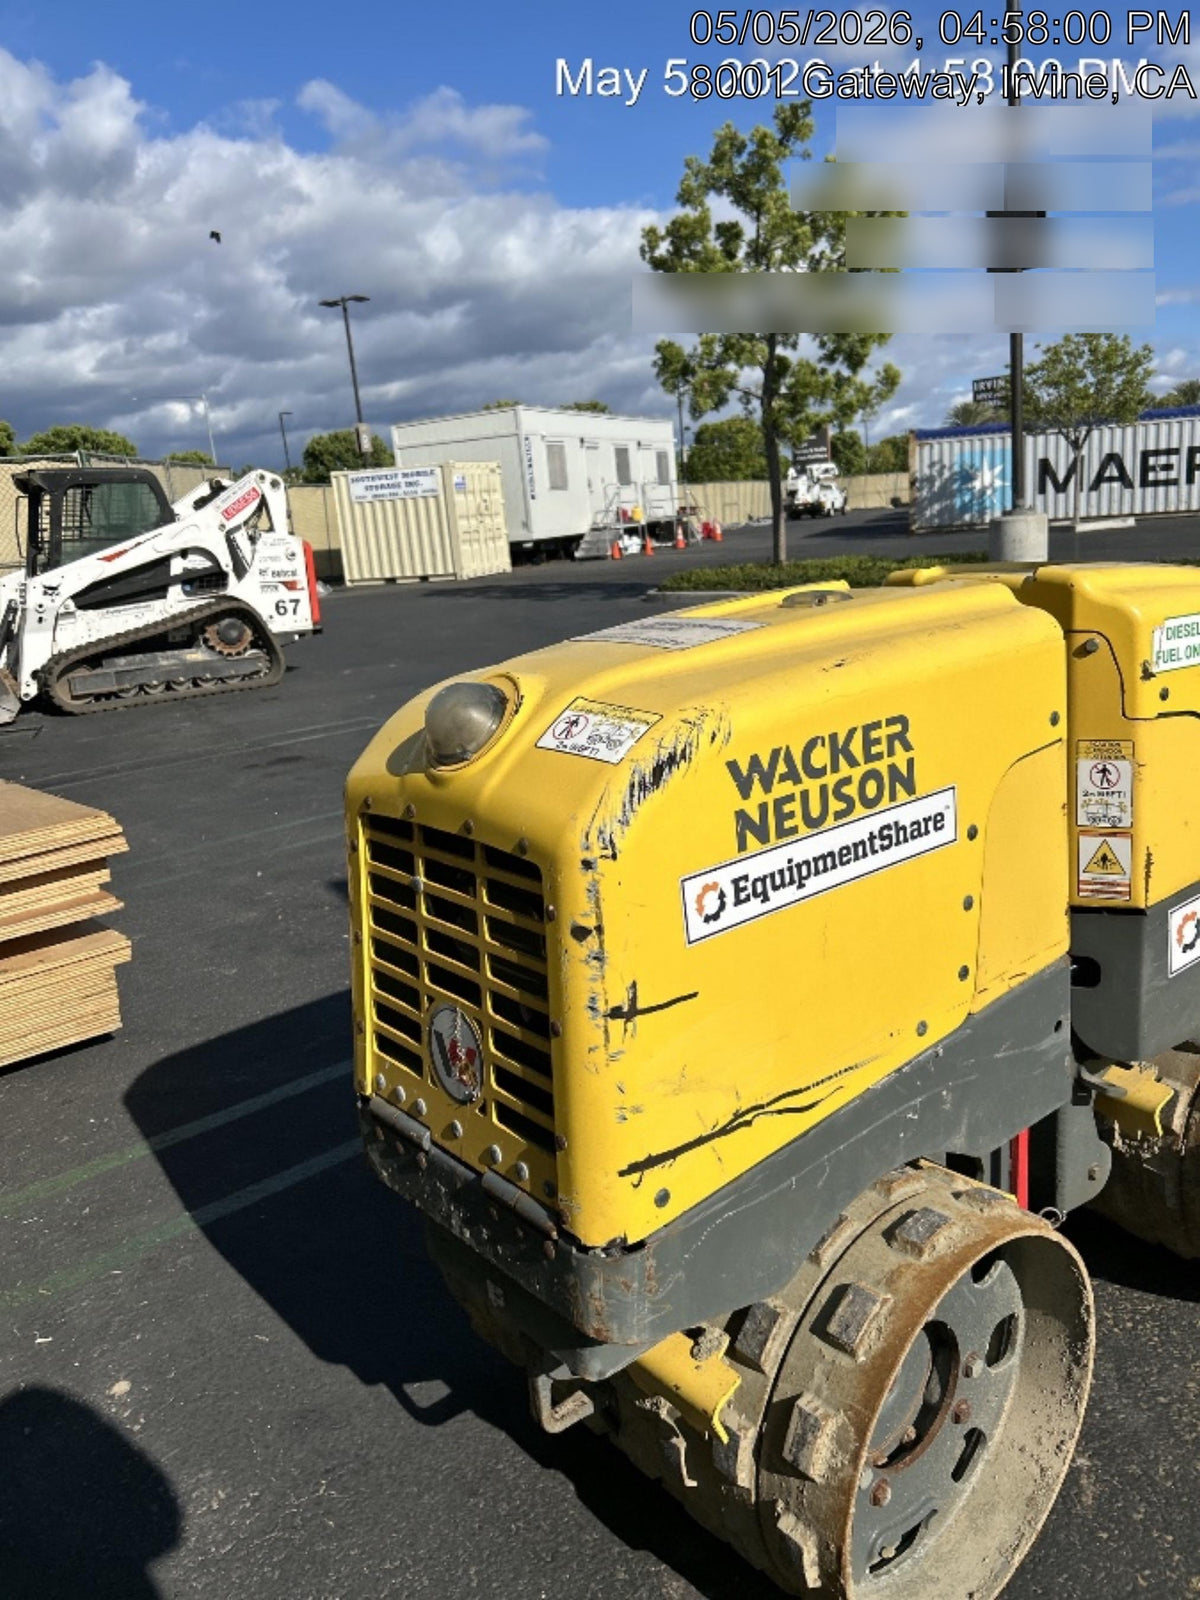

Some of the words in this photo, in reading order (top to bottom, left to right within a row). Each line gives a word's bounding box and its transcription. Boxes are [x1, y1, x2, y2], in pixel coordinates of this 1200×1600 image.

[274, 598, 301, 616] 67
[1156, 646, 1183, 666] FUEL
[725, 714, 914, 801] WACKER
[734, 757, 917, 853] NEUSON
[731, 811, 946, 907] EquipmentShare
